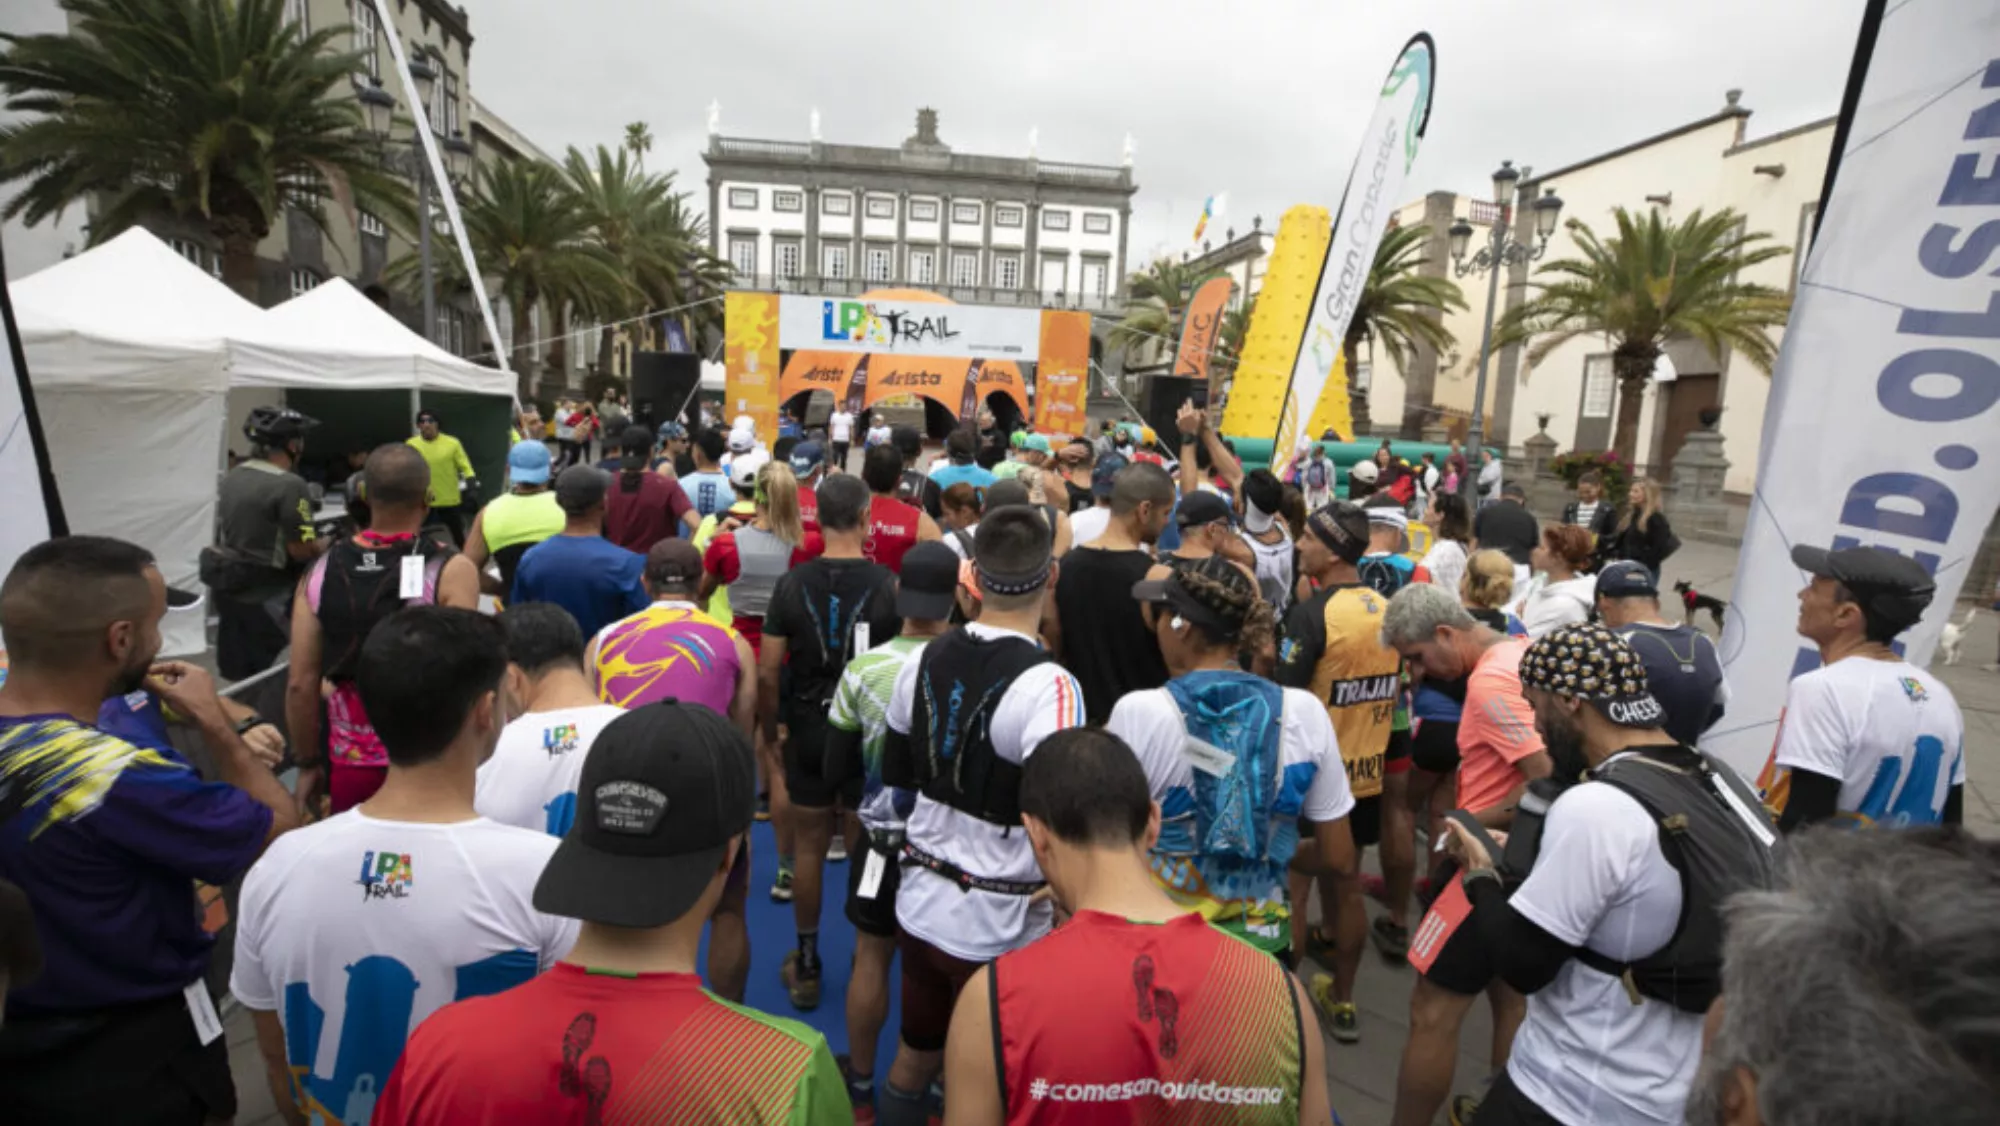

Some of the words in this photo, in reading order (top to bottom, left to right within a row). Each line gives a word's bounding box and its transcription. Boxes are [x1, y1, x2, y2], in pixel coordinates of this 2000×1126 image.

[1325, 249, 1360, 321] Gran
[822, 301, 885, 343] LPA
[877, 309, 961, 350] TRAIL
[878, 369, 942, 386] Arista
[361, 850, 413, 887] LPA
